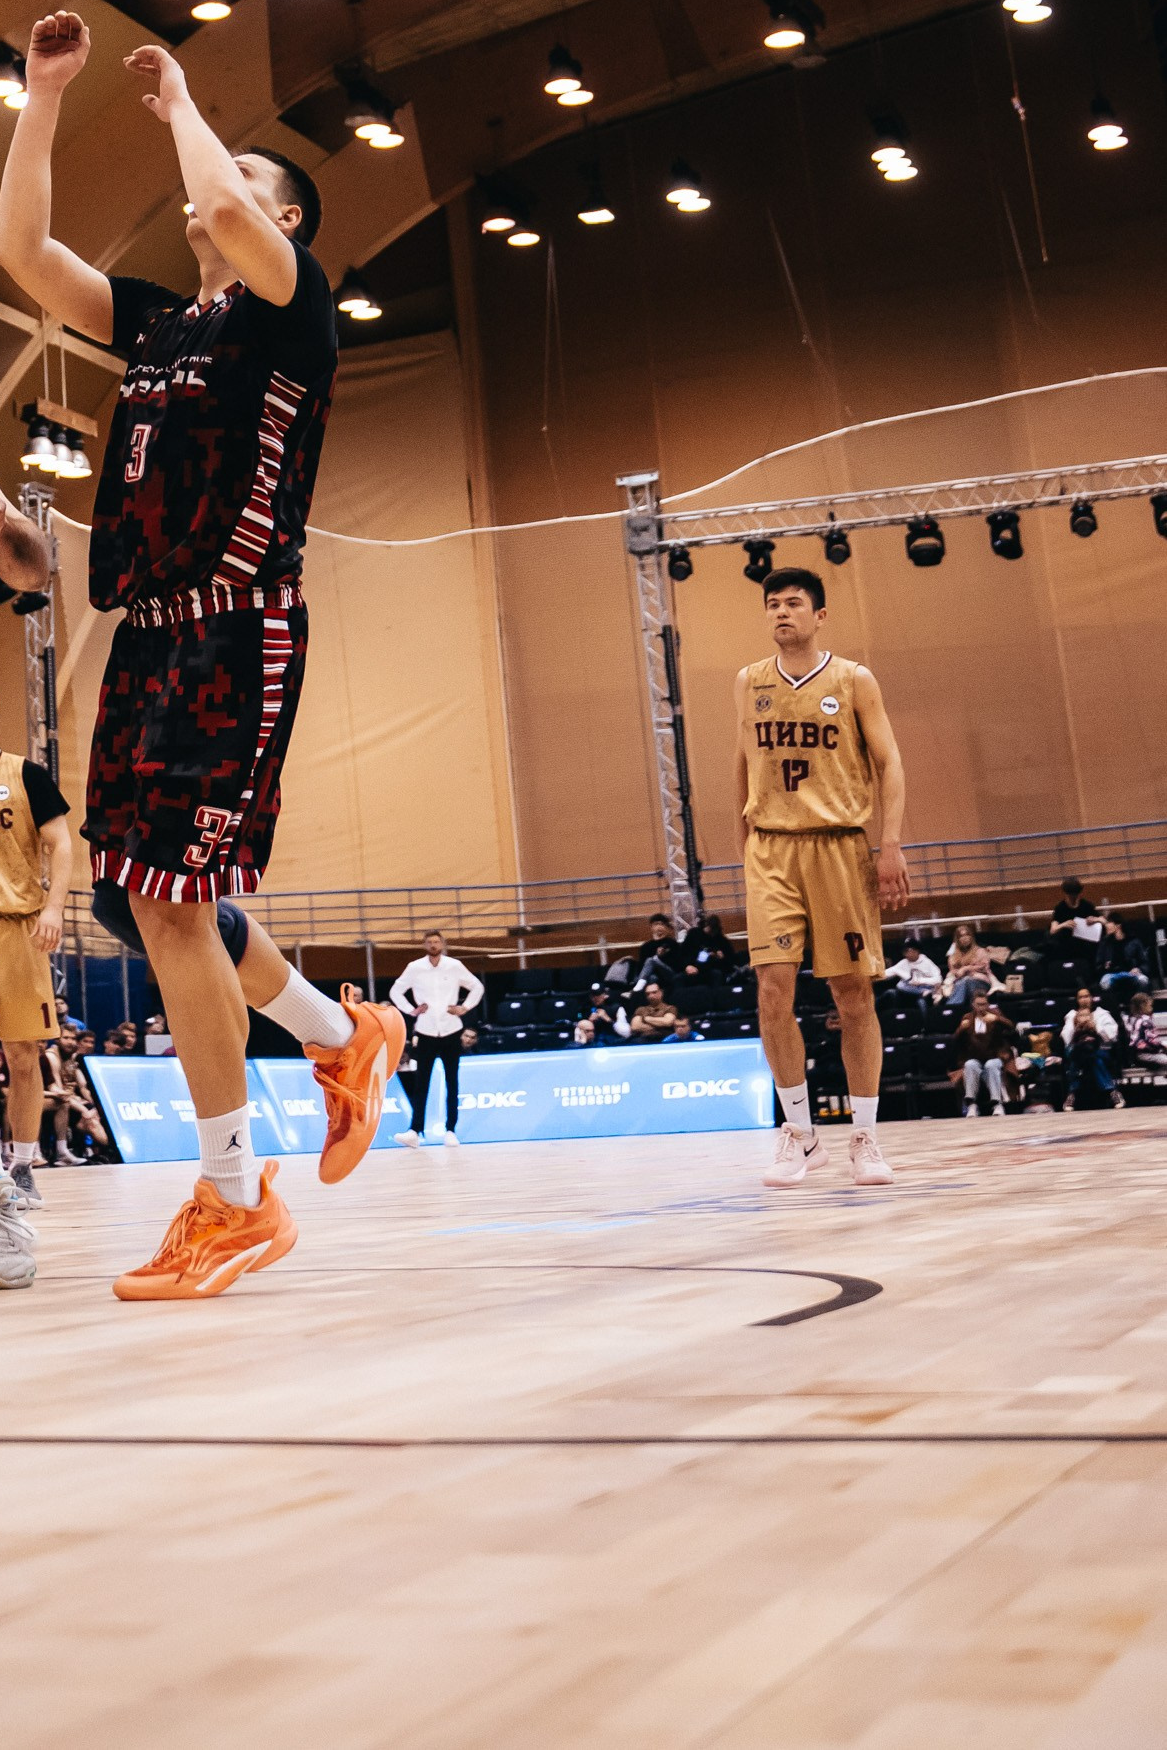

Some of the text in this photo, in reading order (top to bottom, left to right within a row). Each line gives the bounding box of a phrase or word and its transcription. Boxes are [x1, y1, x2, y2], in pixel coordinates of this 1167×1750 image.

[124, 423, 152, 483] 3
[755, 720, 840, 750] ЦИВС
[781, 758, 810, 792] 17
[183, 805, 233, 868] 3
[40, 1002, 51, 1029] 1
[477, 1090, 527, 1109] DKC
[687, 1078, 741, 1098] DKC
